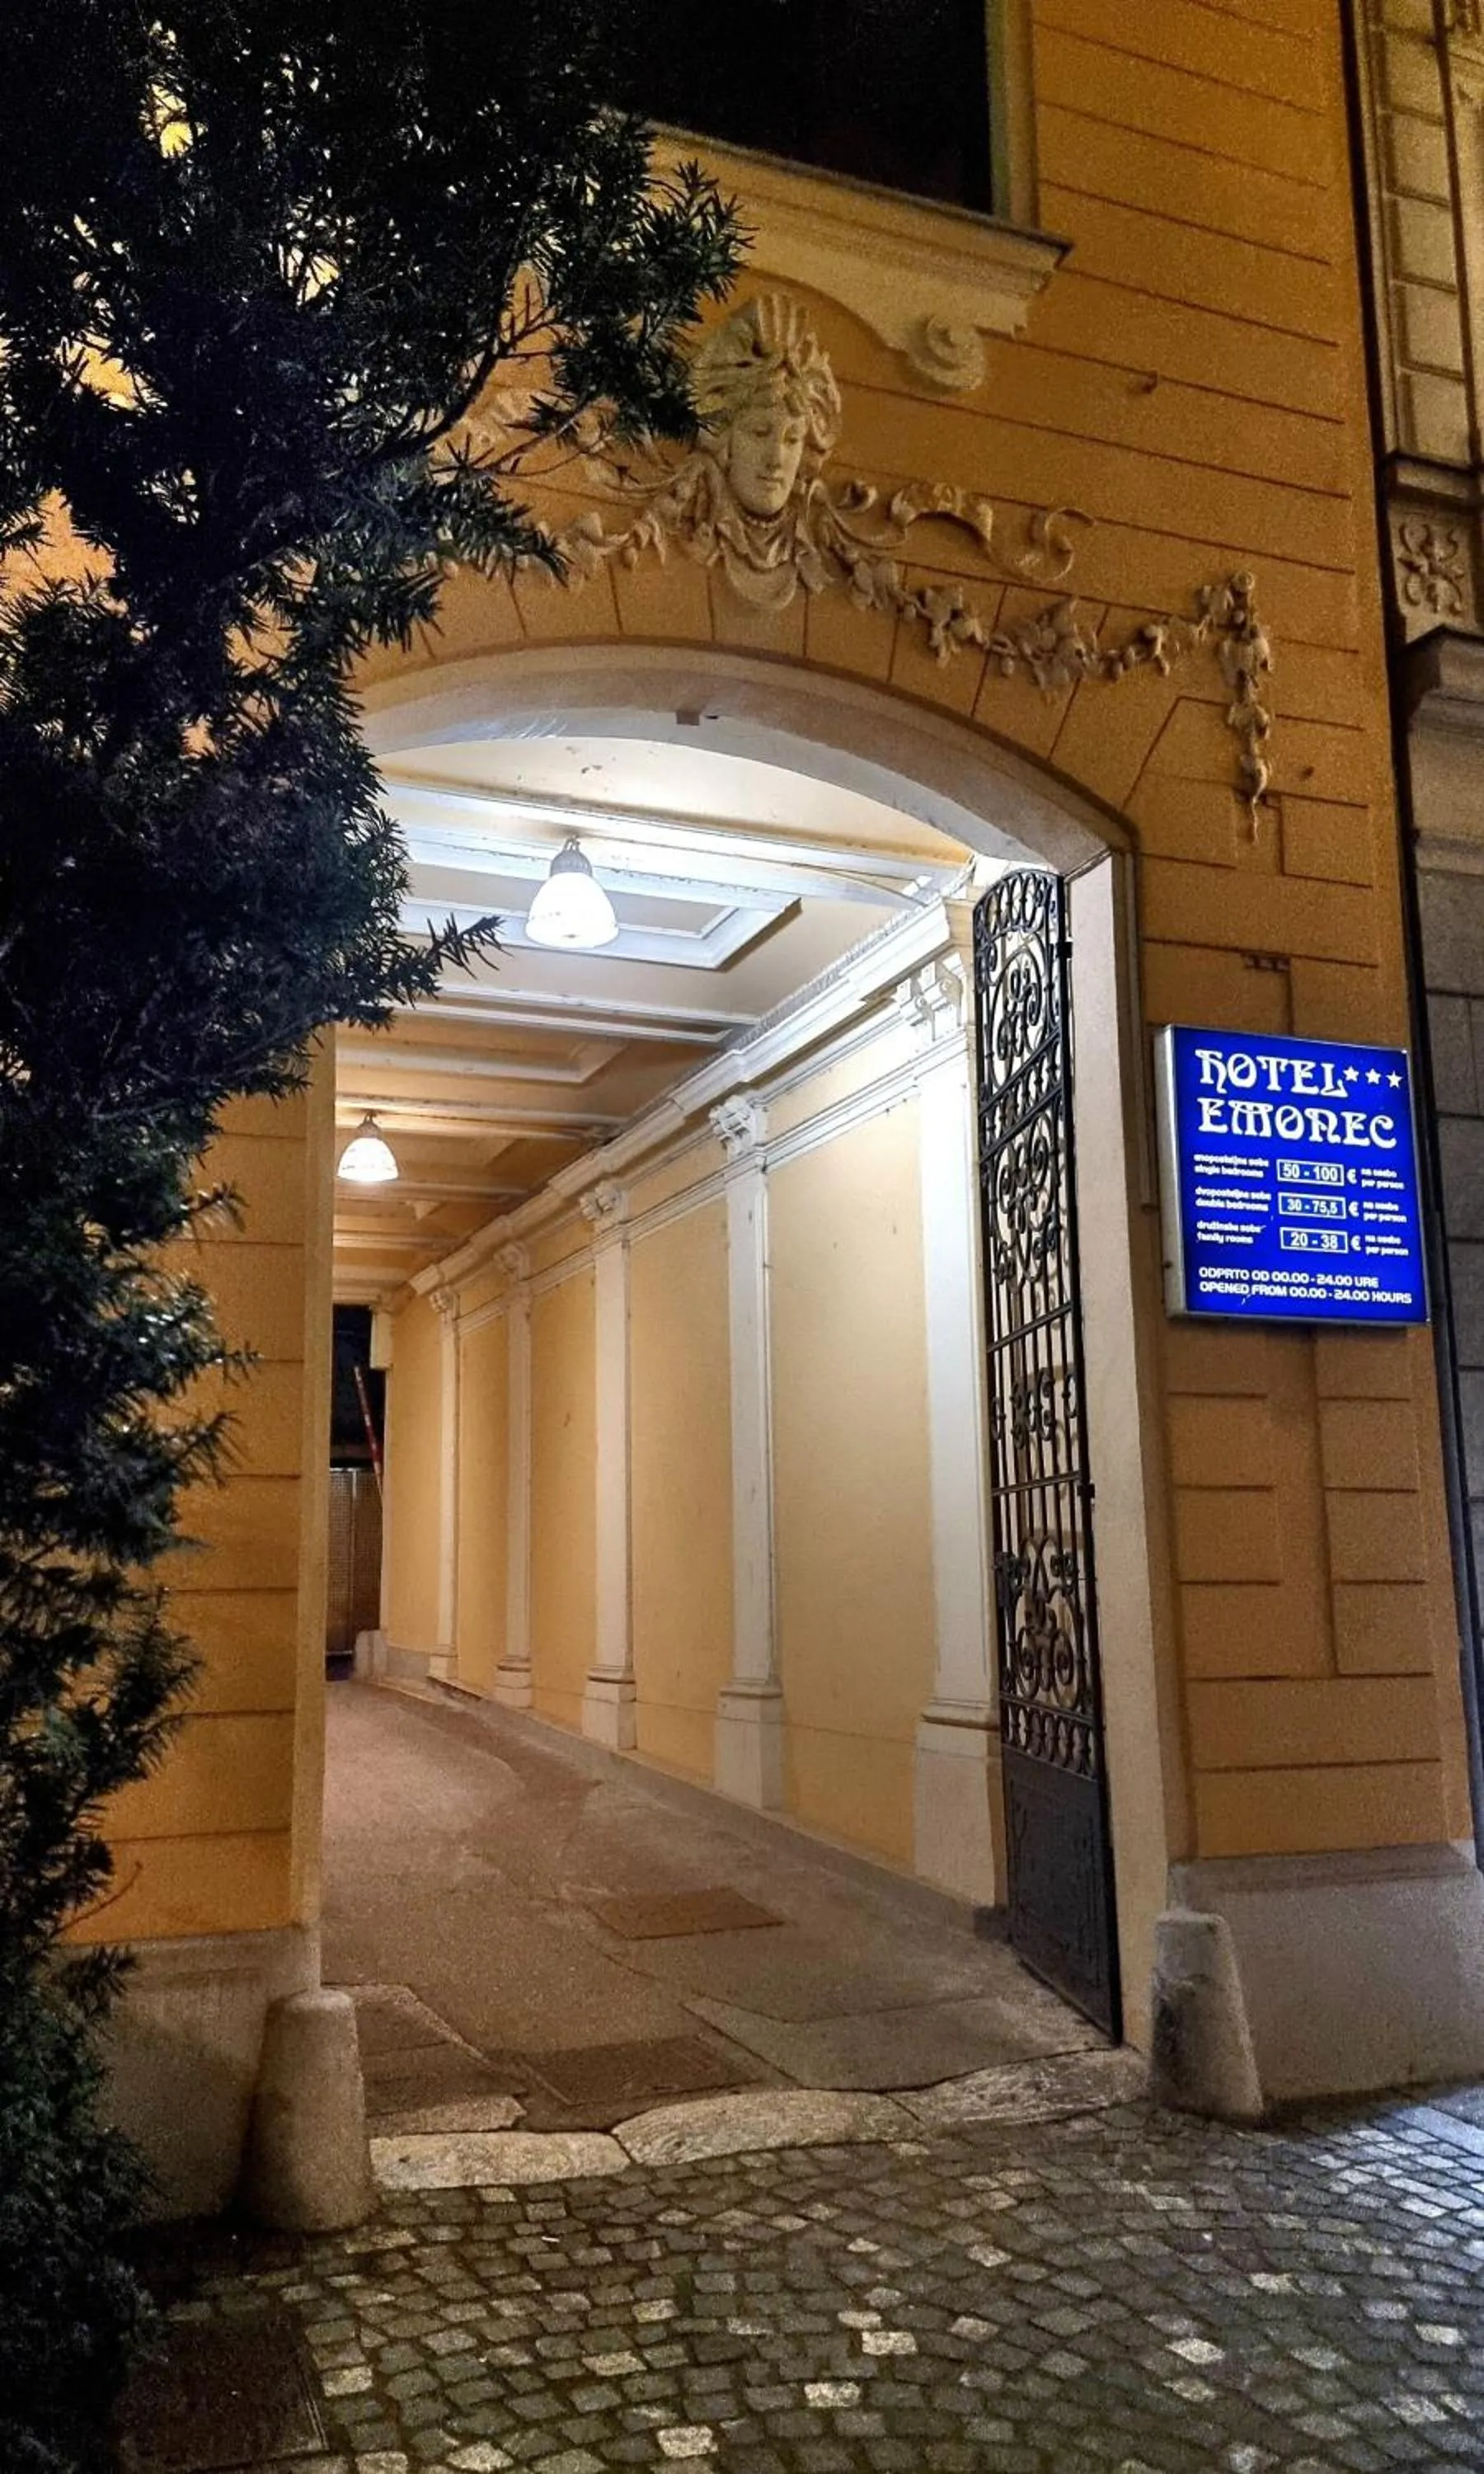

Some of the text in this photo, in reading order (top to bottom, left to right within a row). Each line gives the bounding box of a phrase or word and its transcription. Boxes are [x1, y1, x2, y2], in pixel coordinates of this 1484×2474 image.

[1195, 1048, 1348, 1098] HOTEL
[1196, 1097, 1397, 1148] EMONEC
[1283, 1163, 1300, 1178] 50
[1313, 1165, 1338, 1180] 100
[1347, 1169, 1357, 1184] €
[1361, 1178, 1405, 1190] per person
[1195, 1197, 1225, 1208] double
[1287, 1198, 1302, 1211] 30
[1312, 1200, 1338, 1217] 75,5
[1349, 1202, 1360, 1218] €
[1364, 1211, 1407, 1224] per person
[1225, 1235, 1254, 1244] rooms
[1290, 1232, 1308, 1248] 20
[1321, 1234, 1338, 1249] 38
[1350, 1235, 1361, 1252] €
[1365, 1246, 1409, 1257] per person
[1199, 1266, 1250, 1280] ODPRTO
[1252, 1269, 1270, 1281] OD
[1271, 1272, 1309, 1284] 00.00
[1317, 1273, 1353, 1286] 24.00
[1354, 1276, 1379, 1289] URE
[1200, 1281, 1250, 1295] OPENED
[1251, 1283, 1288, 1297] FROM
[1289, 1286, 1327, 1299] 00.00
[1334, 1288, 1370, 1301] 24.00
[1371, 1291, 1412, 1305] HOURS
